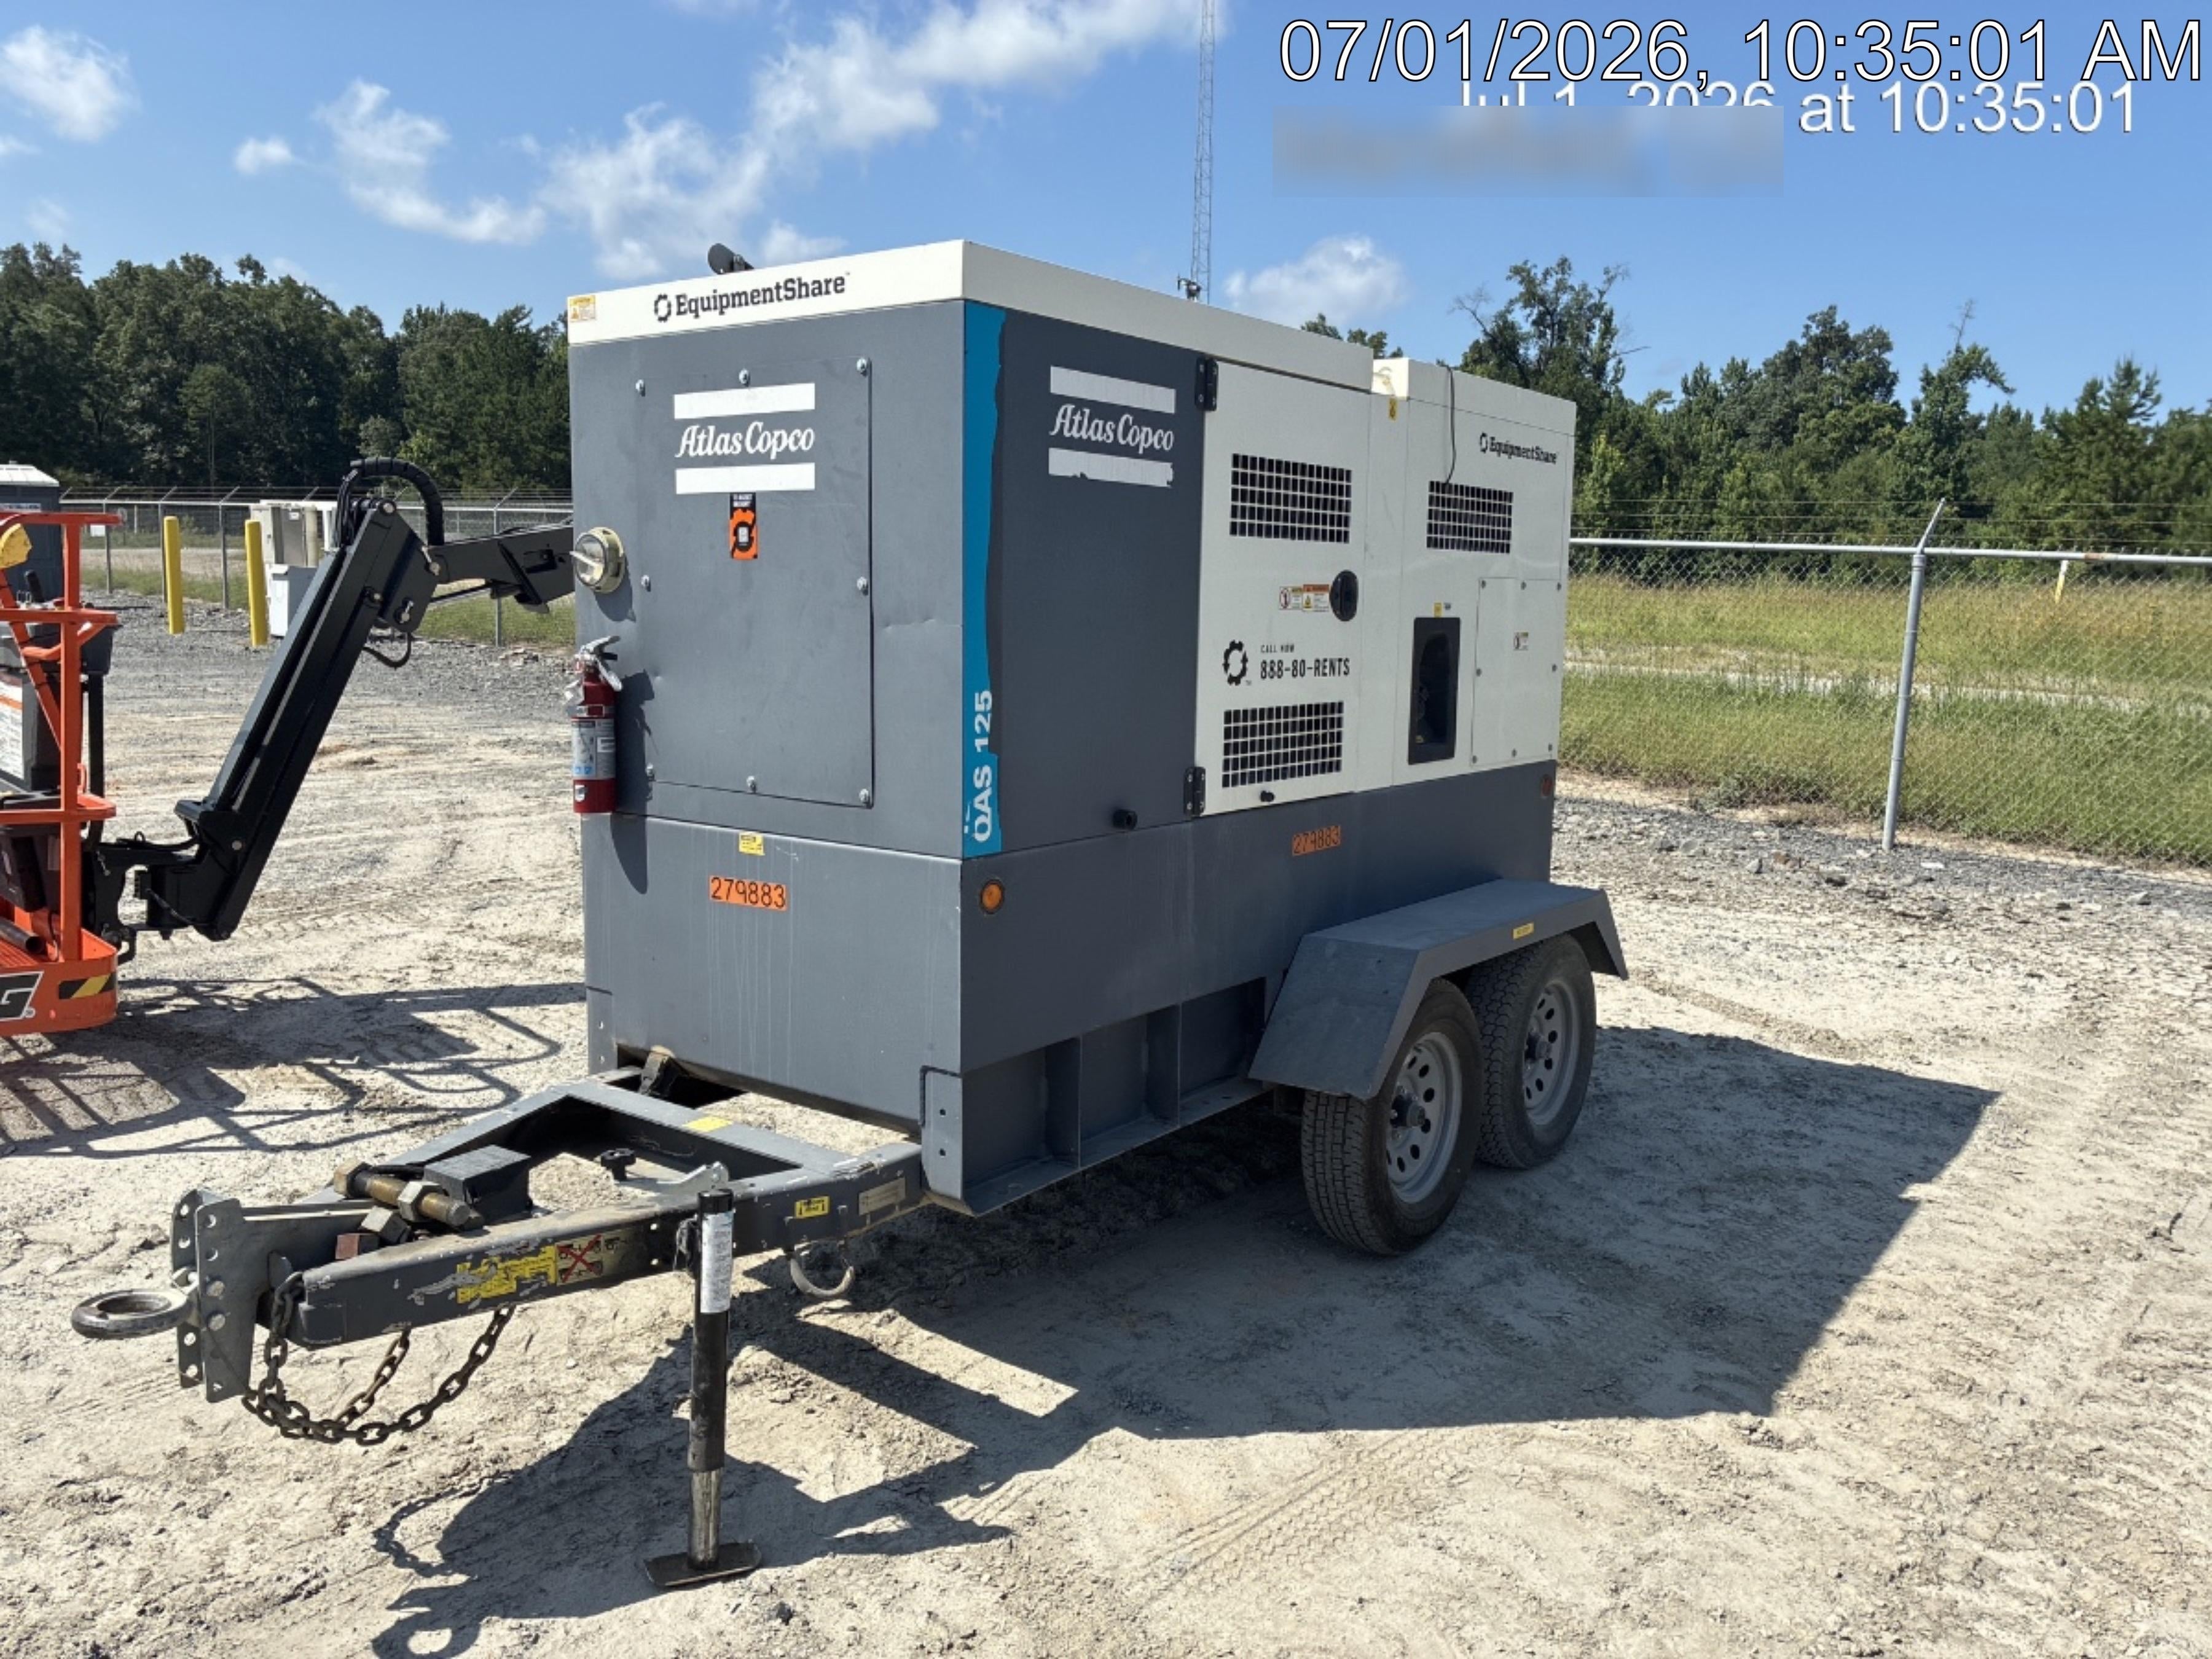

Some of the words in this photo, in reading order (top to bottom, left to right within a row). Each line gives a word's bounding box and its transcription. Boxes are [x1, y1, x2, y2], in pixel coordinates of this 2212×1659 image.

[675, 276, 845, 318] EquipmentShare
[675, 424, 743, 458] Atlas
[745, 421, 815, 460] Copco
[1049, 404, 1116, 444] Atlas
[1117, 414, 1174, 454] Copco
[1260, 657, 1349, 680] 888-80-RENTS
[974, 690, 993, 753] 125
[711, 876, 786, 908] 279883
